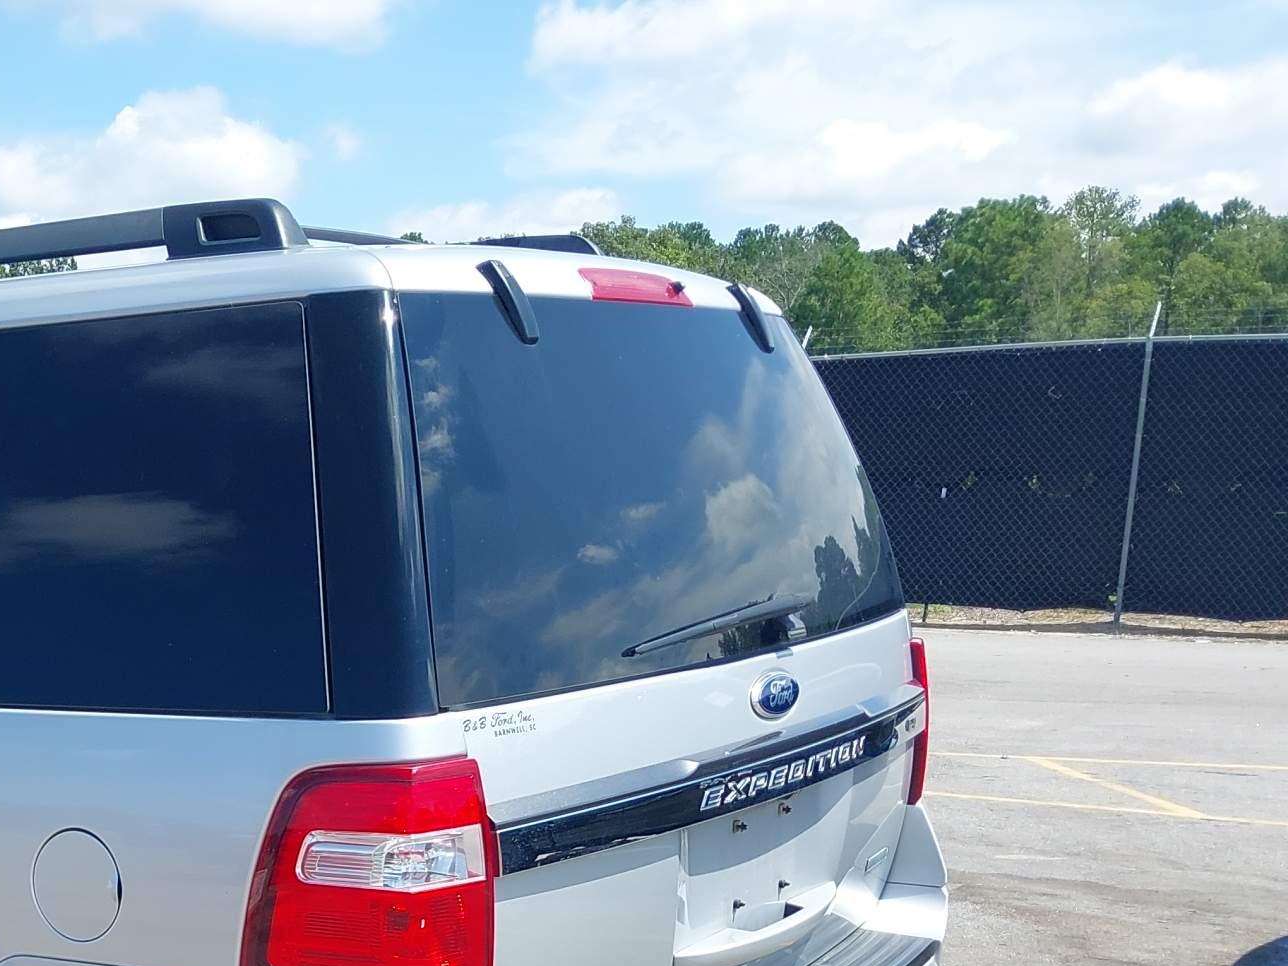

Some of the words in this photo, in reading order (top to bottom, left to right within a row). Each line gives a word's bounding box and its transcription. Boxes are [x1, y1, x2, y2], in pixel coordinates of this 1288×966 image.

[769, 679, 793, 708] Ford
[462, 716, 487, 733] B&B
[699, 735, 867, 812] EXPEDITION
